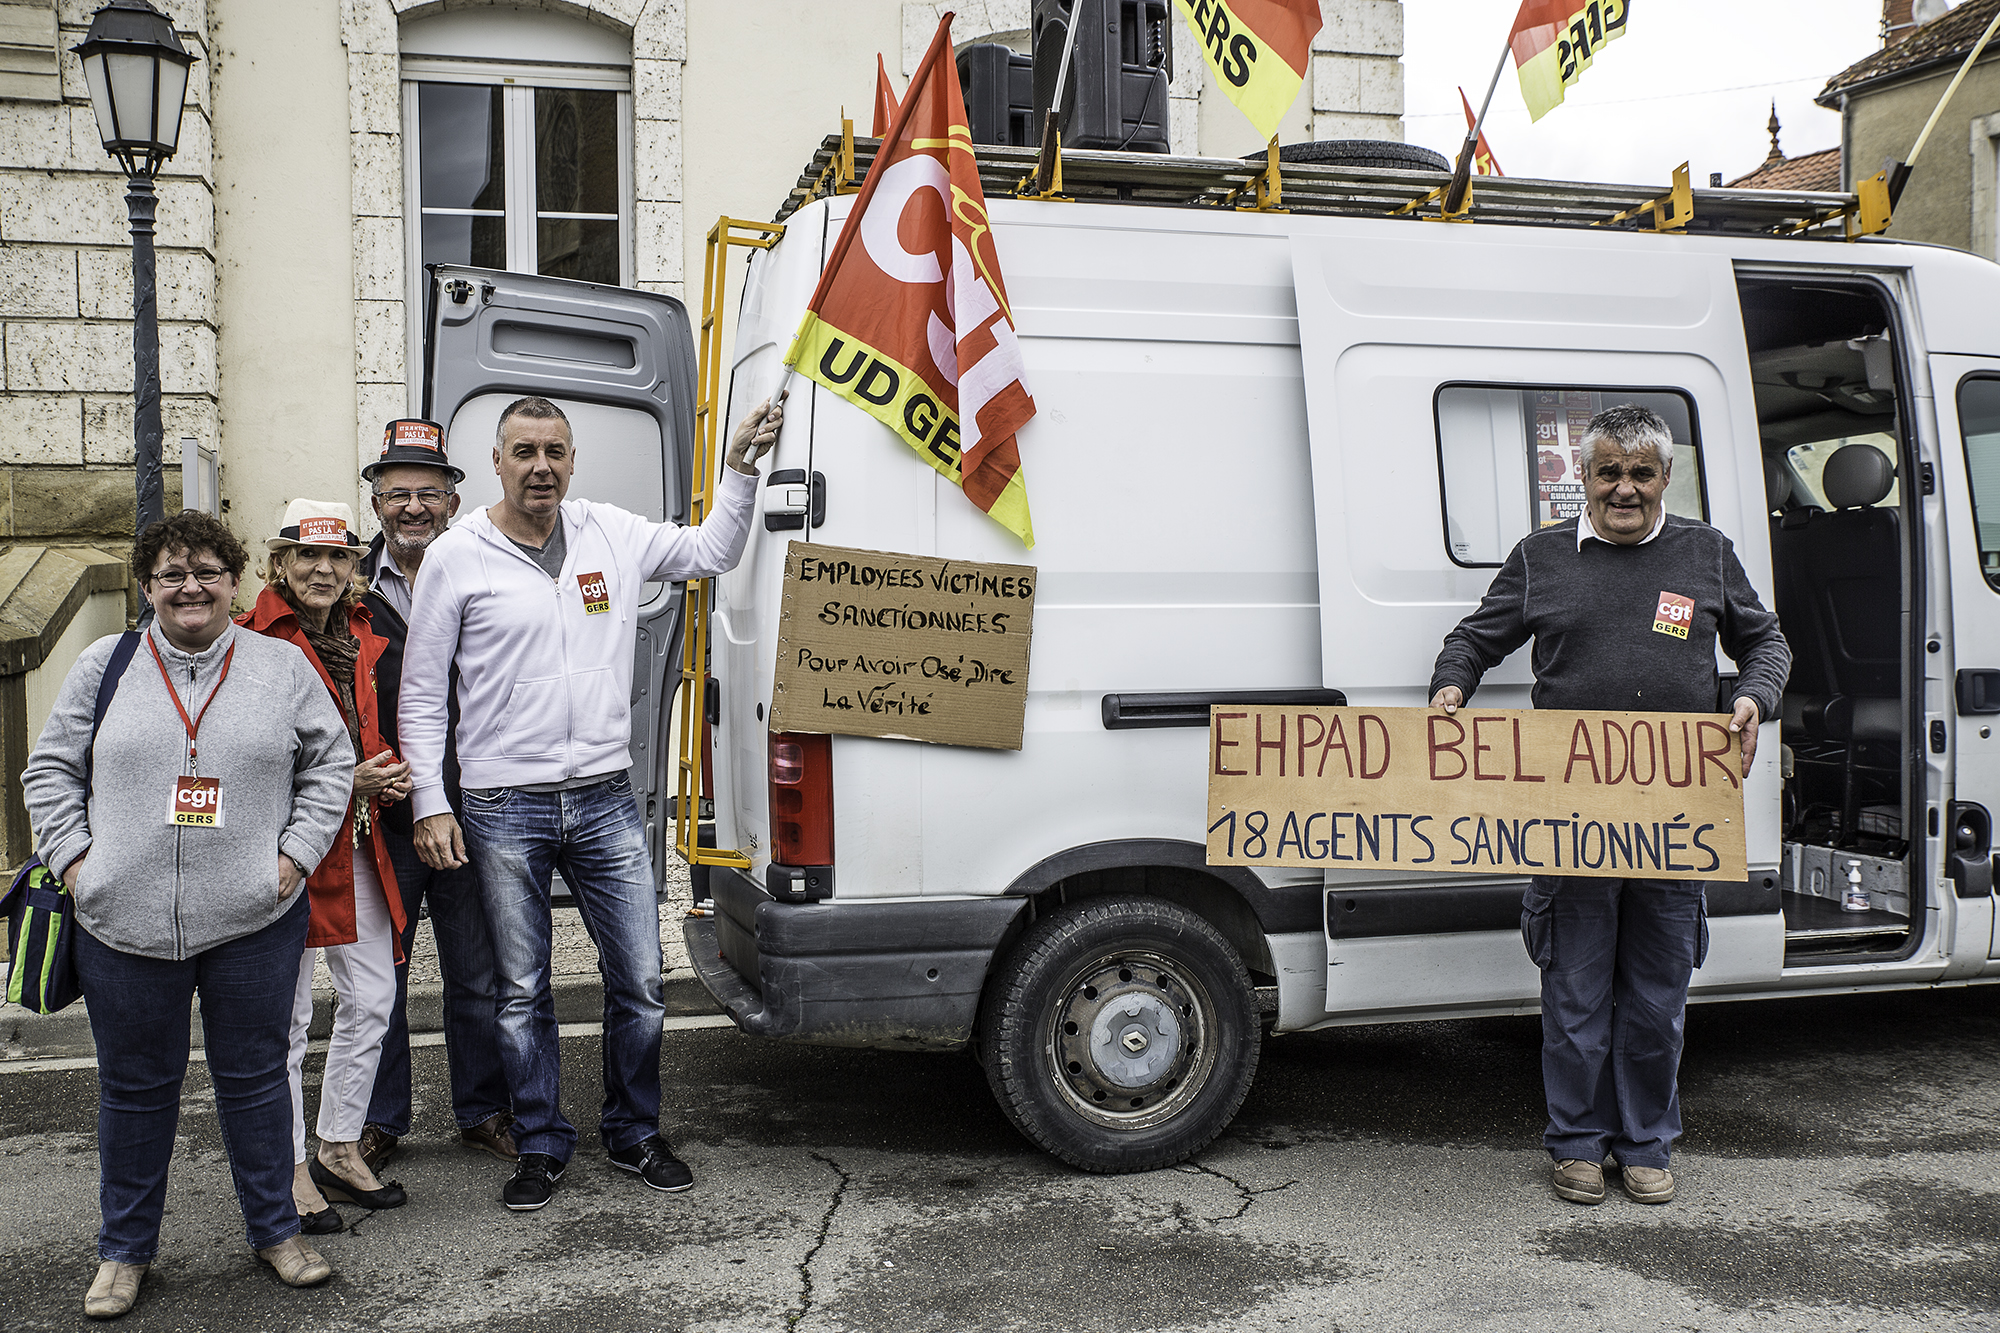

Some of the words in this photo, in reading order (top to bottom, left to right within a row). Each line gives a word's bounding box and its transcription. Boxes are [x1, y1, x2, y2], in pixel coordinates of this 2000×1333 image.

[1185, 0, 1257, 87] ERS
[819, 337, 900, 406] UD
[903, 393, 963, 473] GE
[404, 431, 417, 439] PAS
[417, 429, 426, 439] LÀ
[308, 526, 323, 535] PAS
[323, 524, 333, 534] LÀ
[799, 557, 924, 591] EMPLOYÉES
[581, 579, 606, 599] cgt
[586, 602, 609, 613] GERS
[1659, 602, 1692, 622] cgt
[1655, 623, 1686, 637] GERS
[1215, 713, 1391, 780] EHPAD
[1427, 715, 1546, 782] BEL
[1563, 718, 1739, 790] ADOUR
[178, 787, 216, 808] cgt
[176, 813, 213, 824] GERS
[1208, 811, 1269, 859] 18
[1276, 811, 1435, 864] AGENTS
